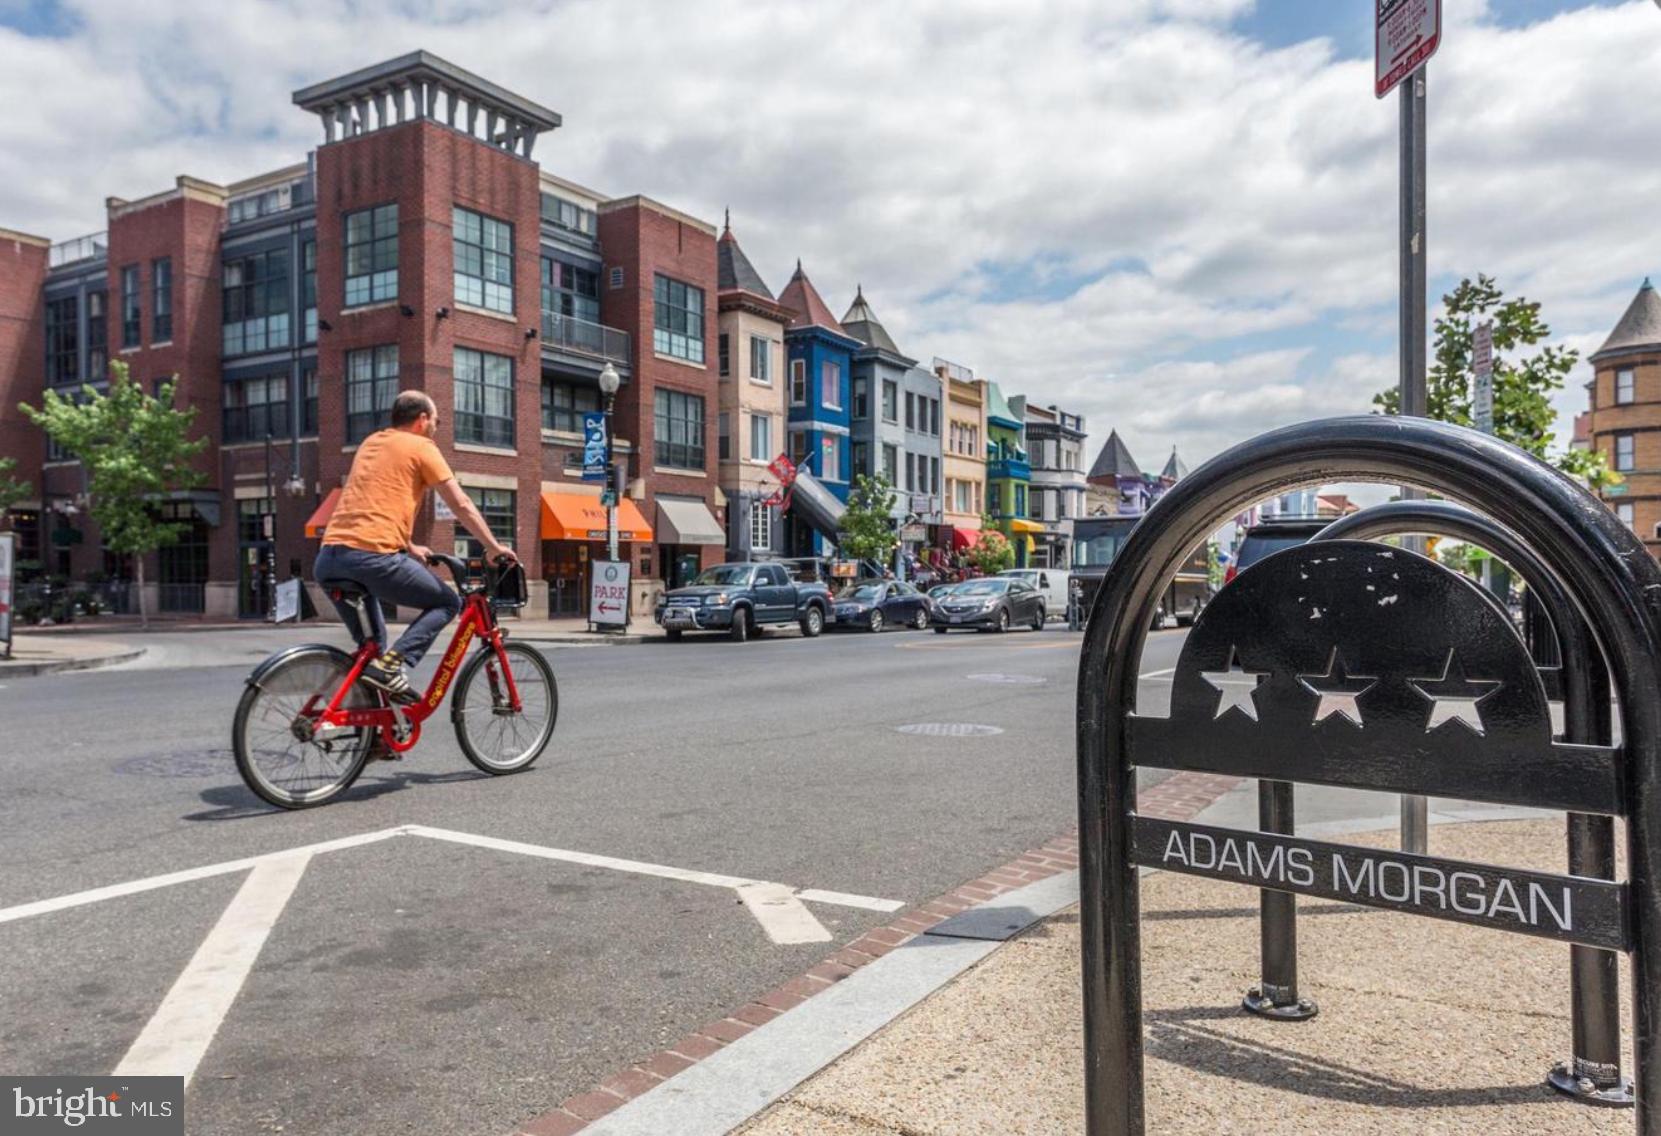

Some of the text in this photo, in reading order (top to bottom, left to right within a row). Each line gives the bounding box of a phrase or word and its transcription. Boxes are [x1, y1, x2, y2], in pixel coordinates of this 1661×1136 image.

[594, 584, 626, 600] PARK
[428, 622, 477, 708] capital bikeshare
[1162, 829, 1573, 932] ADAMS MORGAN
